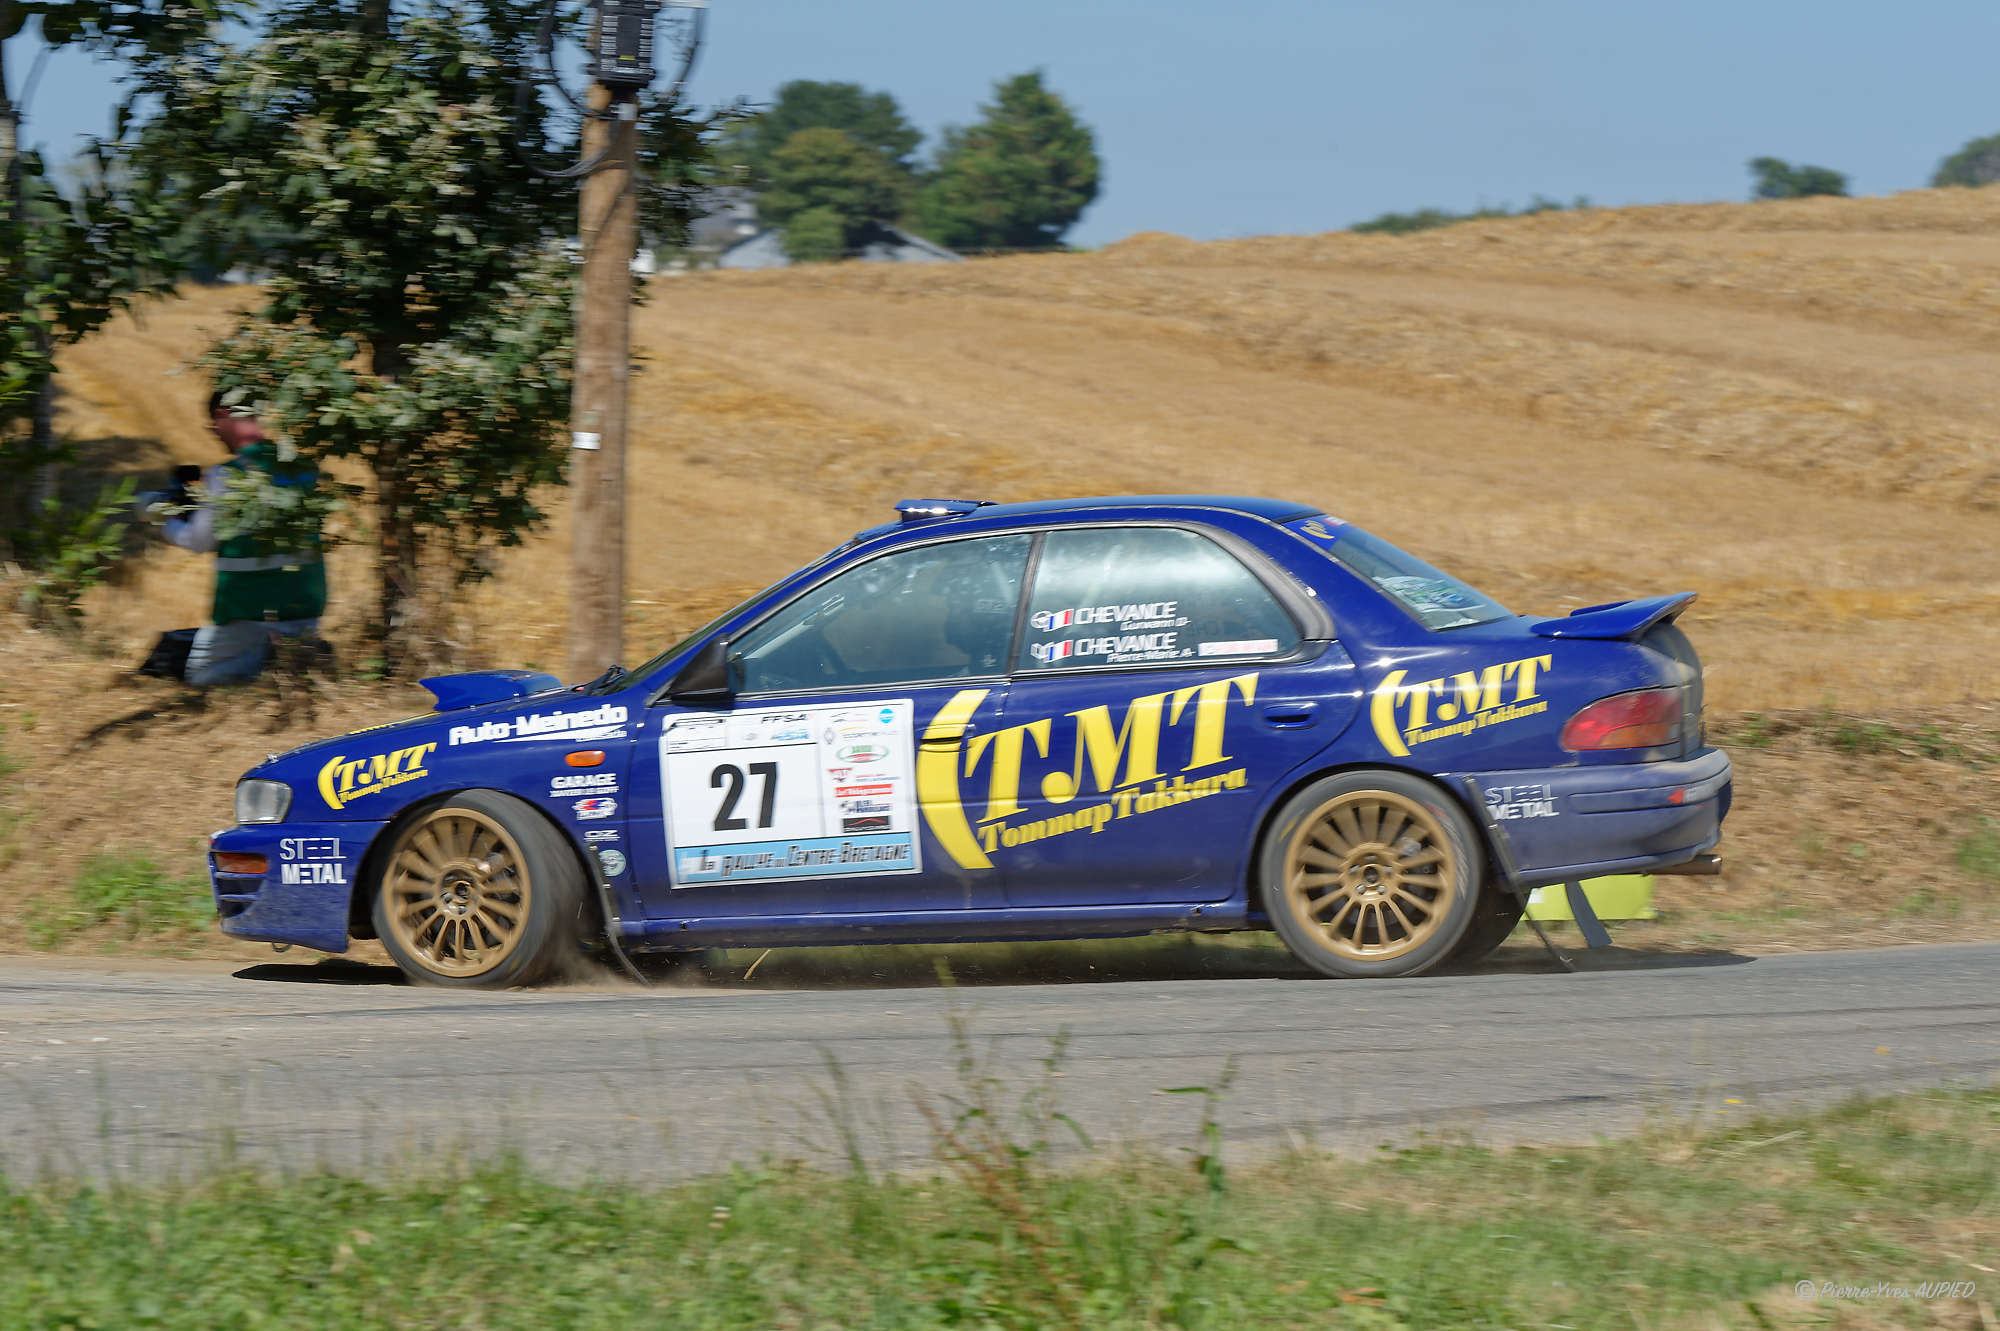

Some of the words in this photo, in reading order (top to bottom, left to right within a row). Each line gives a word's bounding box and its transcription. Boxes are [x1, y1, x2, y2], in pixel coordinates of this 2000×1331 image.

[1074, 601, 1178, 625] CHEVANCE
[1074, 632, 1178, 656] CHEVANCE
[448, 703, 628, 746] Auto-Meinedo
[550, 772, 617, 789] GARAGE
[710, 761, 778, 832] 27
[1484, 783, 1559, 805] STEEL
[1485, 800, 1561, 821] METAL
[279, 837, 348, 860] STEEL
[281, 863, 348, 885] METAL
